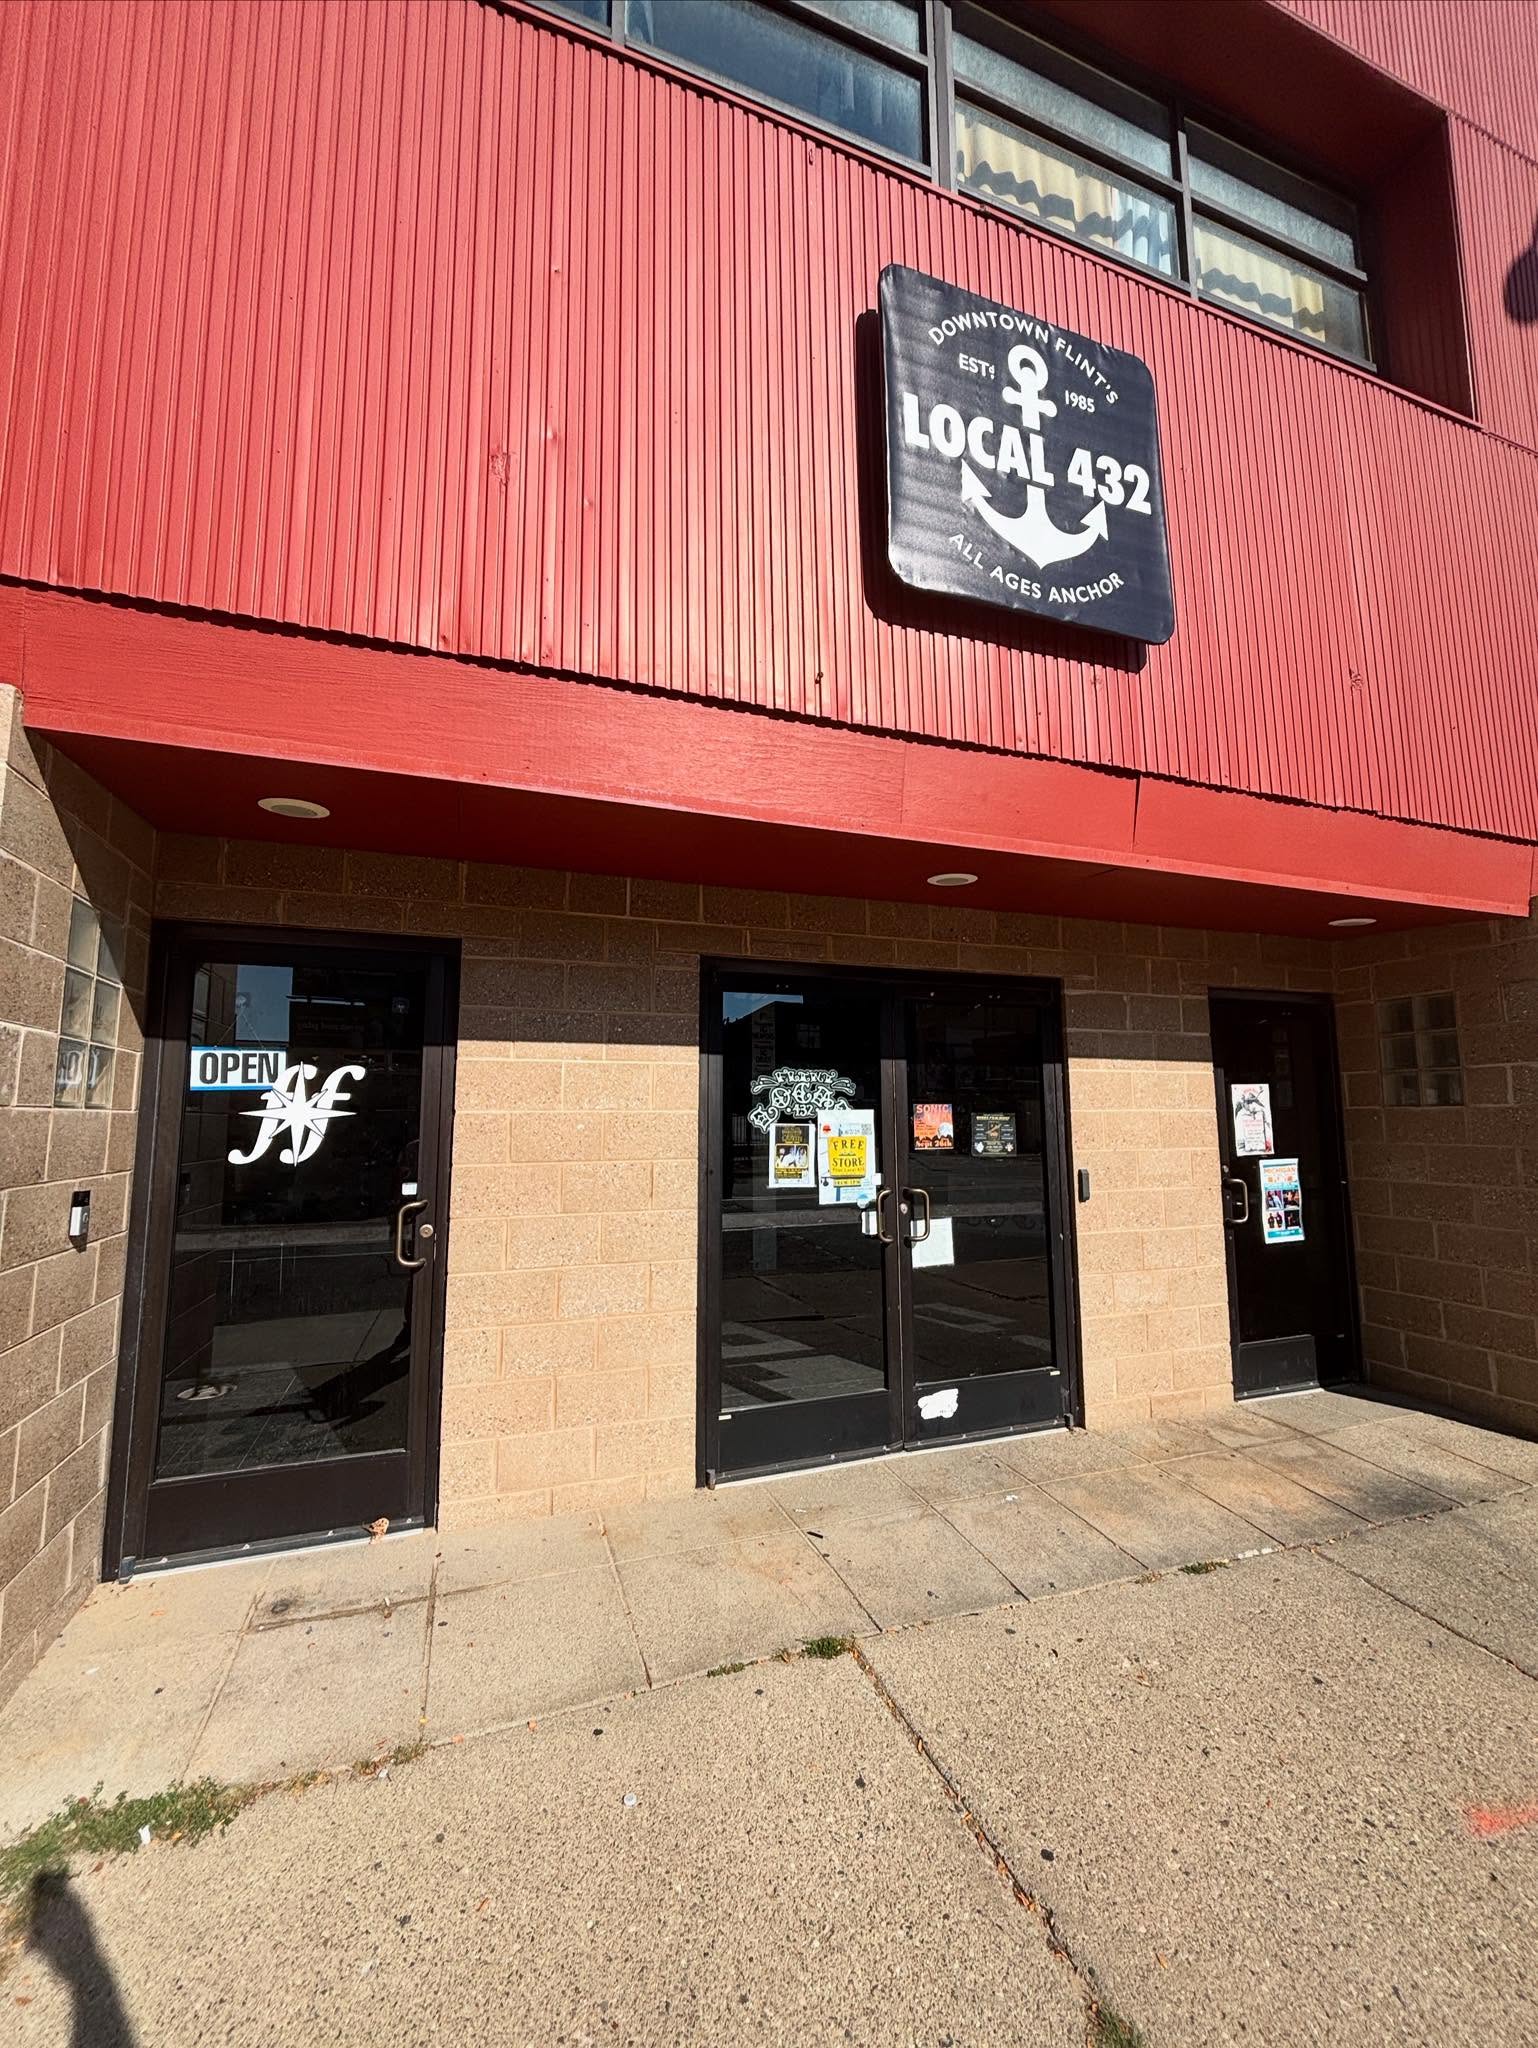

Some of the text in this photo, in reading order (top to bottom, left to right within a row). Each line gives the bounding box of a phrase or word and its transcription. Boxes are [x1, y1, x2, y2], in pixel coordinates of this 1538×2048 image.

[928, 312, 1119, 405] DOWNTOWN FLINT'S
[1064, 390, 1096, 413] 1985
[902, 392, 1152, 515] LOCAL 432
[948, 533, 1125, 604] ALL AGES ANCHOR
[200, 1052, 279, 1085] OPEN
[774, 1070, 836, 1083] FLINT
[793, 1104, 815, 1117] 432
[916, 1104, 949, 1114] SONIC
[833, 1139, 865, 1151] FREE
[832, 1156, 865, 1168] STORE
